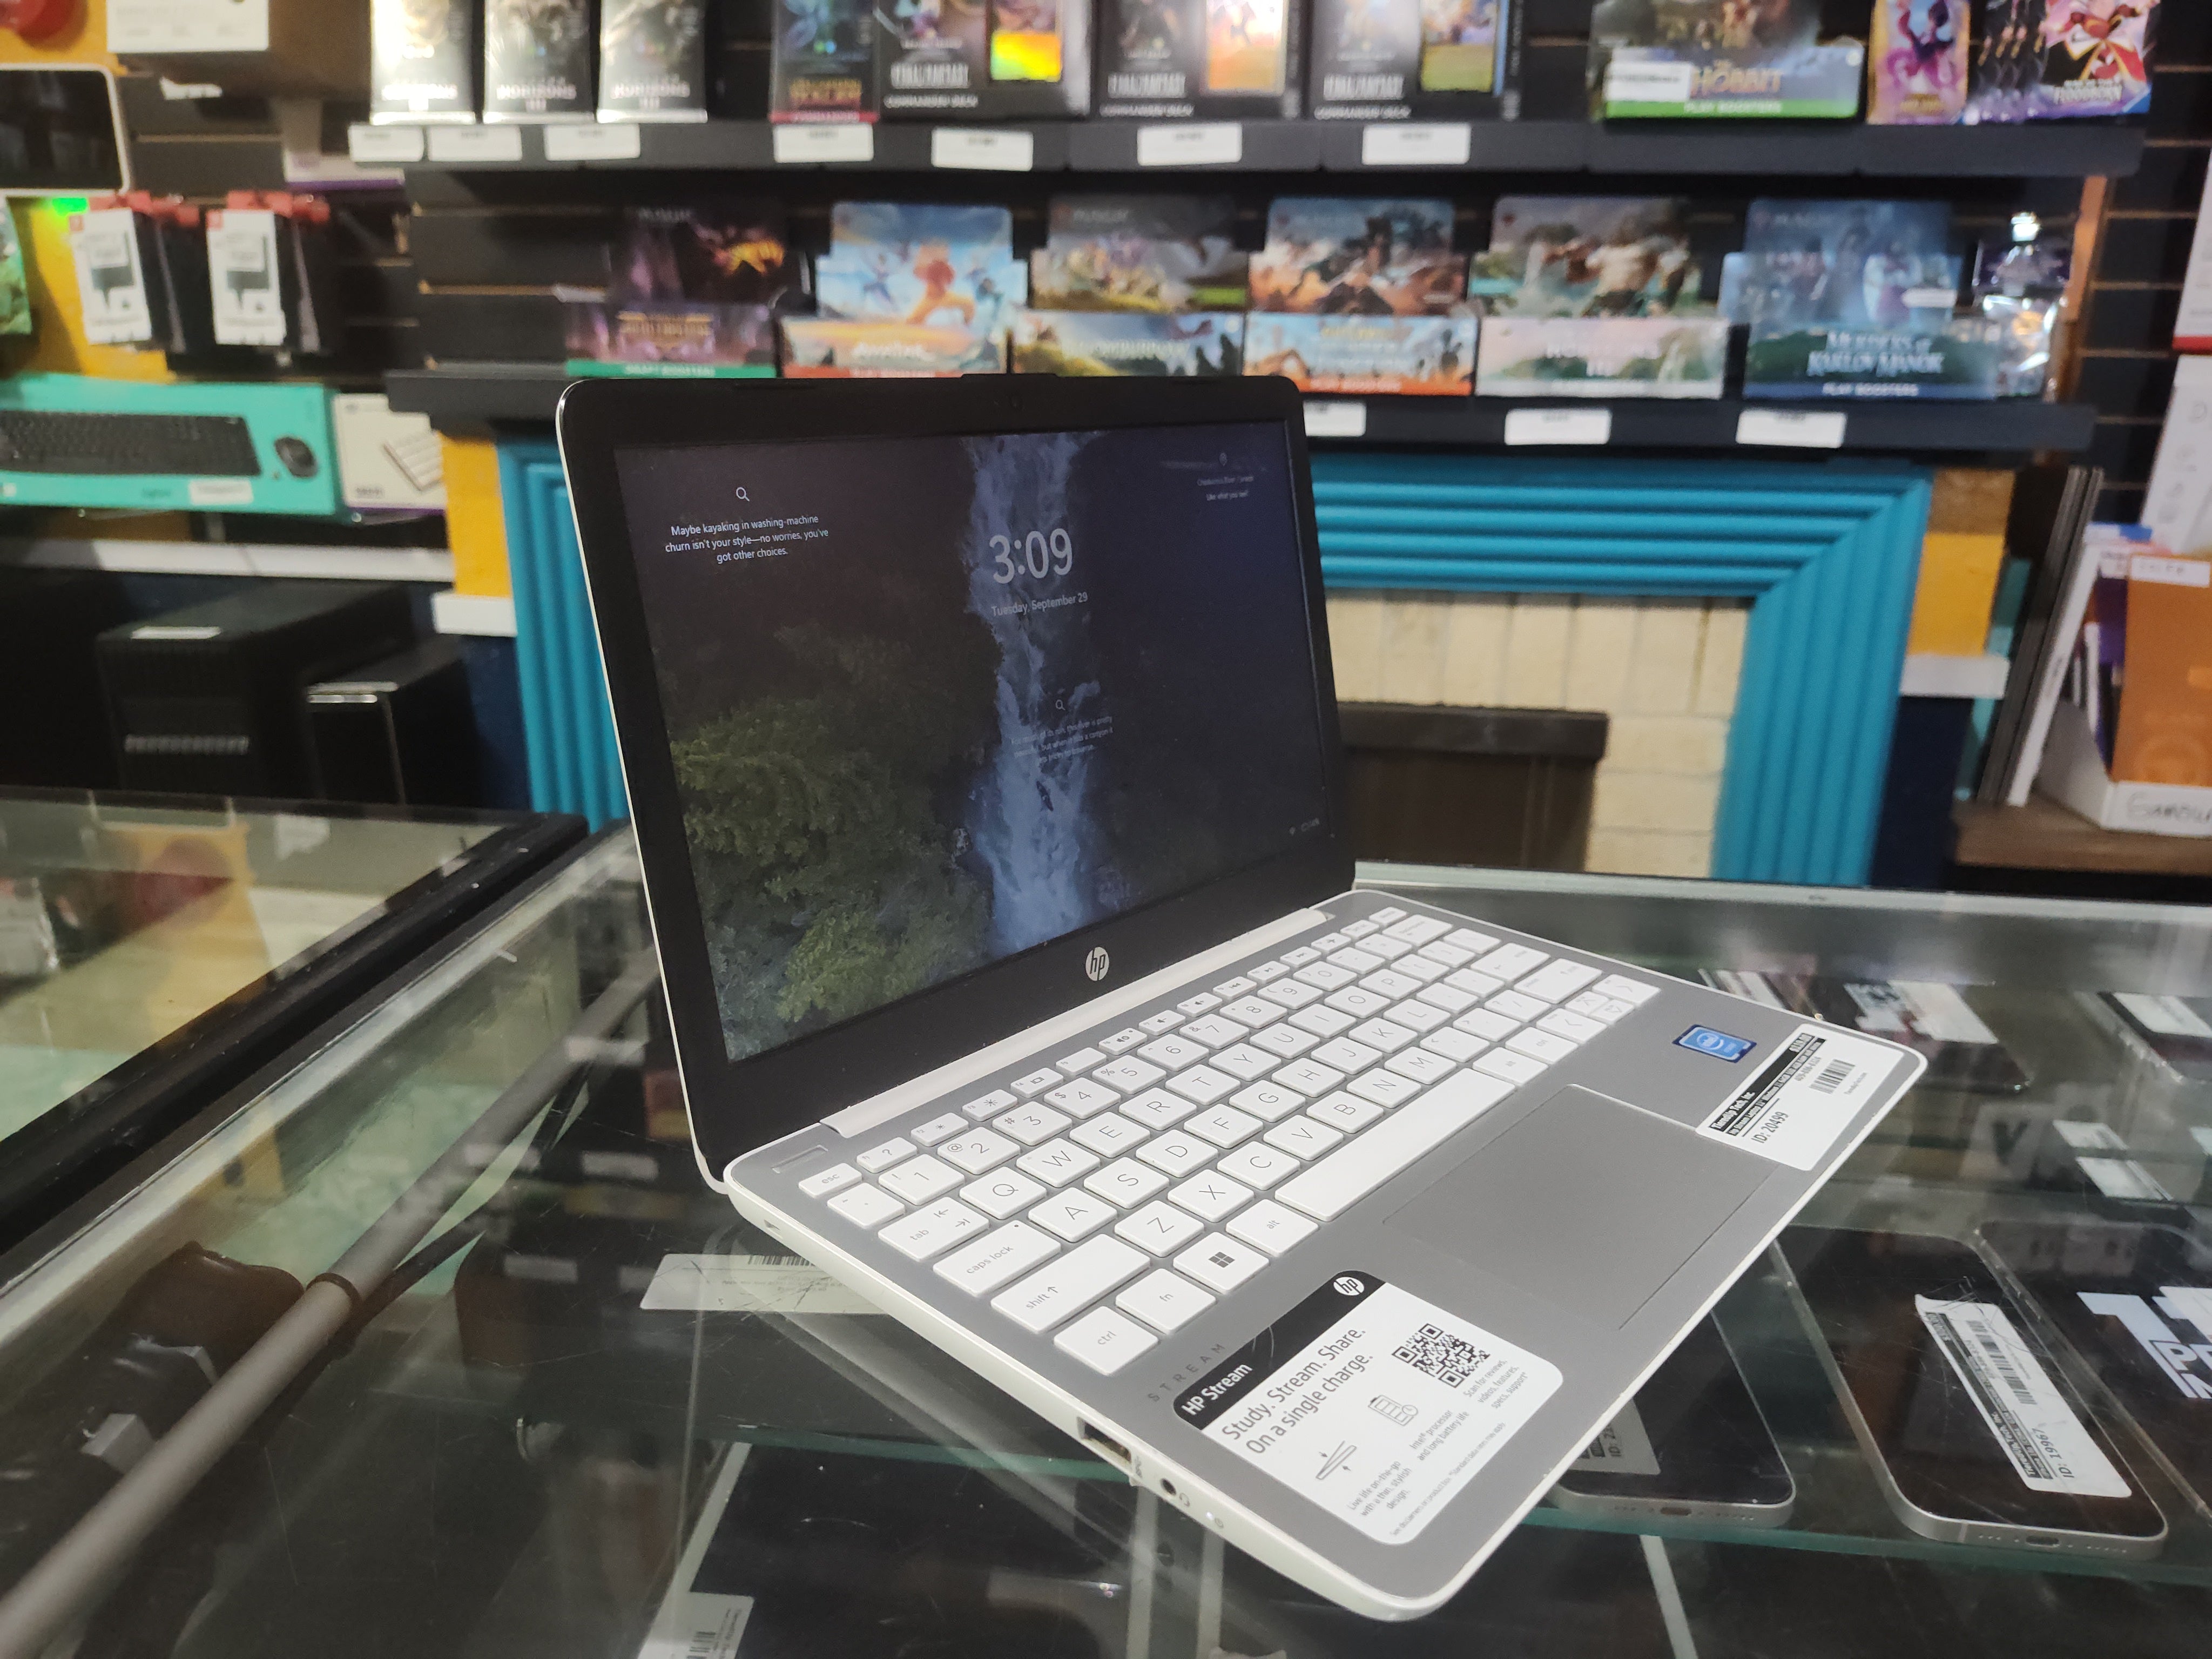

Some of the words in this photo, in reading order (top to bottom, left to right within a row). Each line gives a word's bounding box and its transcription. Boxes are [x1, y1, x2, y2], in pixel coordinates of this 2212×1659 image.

[671, 524, 701, 537] Maybe
[703, 521, 740, 535] kayaking
[741, 520, 750, 531] in
[751, 515, 819, 530] washing-machine
[665, 541, 691, 553] churn
[692, 538, 711, 550] isn't
[712, 539, 731, 550] your
[772, 530, 802, 542] worries,
[804, 529, 829, 541] you've
[717, 552, 732, 564] got
[733, 550, 756, 561] other
[757, 547, 788, 558] choices.
[989, 528, 1073, 584] 3:09
[991, 602, 1030, 617] Tuesday,
[1031, 595, 1076, 612] September
[1077, 592, 1088, 603] 29
[1088, 947, 1108, 981] hp
[1381, 978, 1397, 987] P
[1348, 995, 1365, 1003] O
[1206, 1024, 1220, 1033] 7
[1372, 1028, 1394, 1038] K
[1273, 1033, 1294, 1042] U
[1165, 1046, 1181, 1054] 6
[1342, 1048, 1357, 1057] J
[1233, 1054, 1253, 1064] Y
[1408, 1056, 1434, 1069] M
[1121, 1067, 1138, 1076] 5
[1297, 1068, 1321, 1080] H
[1192, 1076, 1211, 1087] T
[1372, 1079, 1397, 1091] N
[1078, 1091, 1092, 1100] 4
[1258, 1092, 1279, 1103] G
[1147, 1101, 1171, 1113] R
[1334, 1104, 1356, 1116] B
[1004, 1117, 1015, 1125] #
[1023, 1116, 1042, 1126] 3
[1213, 1117, 1229, 1130] F
[1751, 1131, 1771, 1143] ID:
[1761, 1111, 1789, 1133] 20499
[1099, 1125, 1123, 1138] E
[1291, 1127, 1313, 1138] V
[947, 1143, 963, 1152] @
[971, 1143, 990, 1154] 2
[1165, 1146, 1188, 1158] D
[1042, 1150, 1072, 1168] W
[1250, 1156, 1272, 1168] C
[821, 1172, 840, 1185] esc
[914, 1171, 929, 1181] 1
[1117, 1174, 1139, 1186] S
[993, 1183, 1019, 1197] Q
[1199, 1184, 1226, 1200] X
[1065, 1206, 1088, 1220] A
[1147, 1217, 1175, 1233] Z
[1266, 1219, 1280, 1229] alt
[910, 1228, 929, 1241] tab
[966, 1258, 992, 1274] caps
[990, 1245, 1014, 1260] lock
[1336, 1277, 1362, 1295] hp
[1026, 1293, 1050, 1311] shift
[1159, 1291, 1174, 1302] fn
[1097, 1330, 1116, 1346] ctrl
[1147, 1343, 1226, 1402] STREAM
[1318, 1350, 1375, 1394] charge.
[1462, 1383, 1480, 1397] Scan
[1474, 1376, 1488, 1385] for
[1483, 1358, 1507, 1378] reviews,
[1181, 1395, 1210, 1416] HP
[1199, 1361, 1253, 1401] Stream
[1220, 1398, 1278, 1442] Study.
[1266, 1356, 1327, 1404] Stream.
[1317, 1324, 1366, 1361] Share.
[1276, 1387, 1330, 1429] single
[1425, 1410, 1454, 1435] processor
[1269, 1424, 1287, 1437] a
[1415, 1448, 1431, 1460] and
[1426, 1437, 1444, 1451] long
[1438, 1419, 1462, 1439] battery
[1456, 1410, 1469, 1420] life
[1244, 1431, 1276, 1455] On
[2031, 1428, 2062, 1459] 19967
[2054, 1463, 2075, 1478] ID:
[1346, 1495, 1364, 1510] Live
[1358, 1486, 1373, 1498] life
[1368, 1459, 1403, 1490] on-the-go
[1359, 1501, 1376, 1516] with
[1388, 1466, 1413, 1487] stylish
[1385, 1487, 1411, 1510] design.
